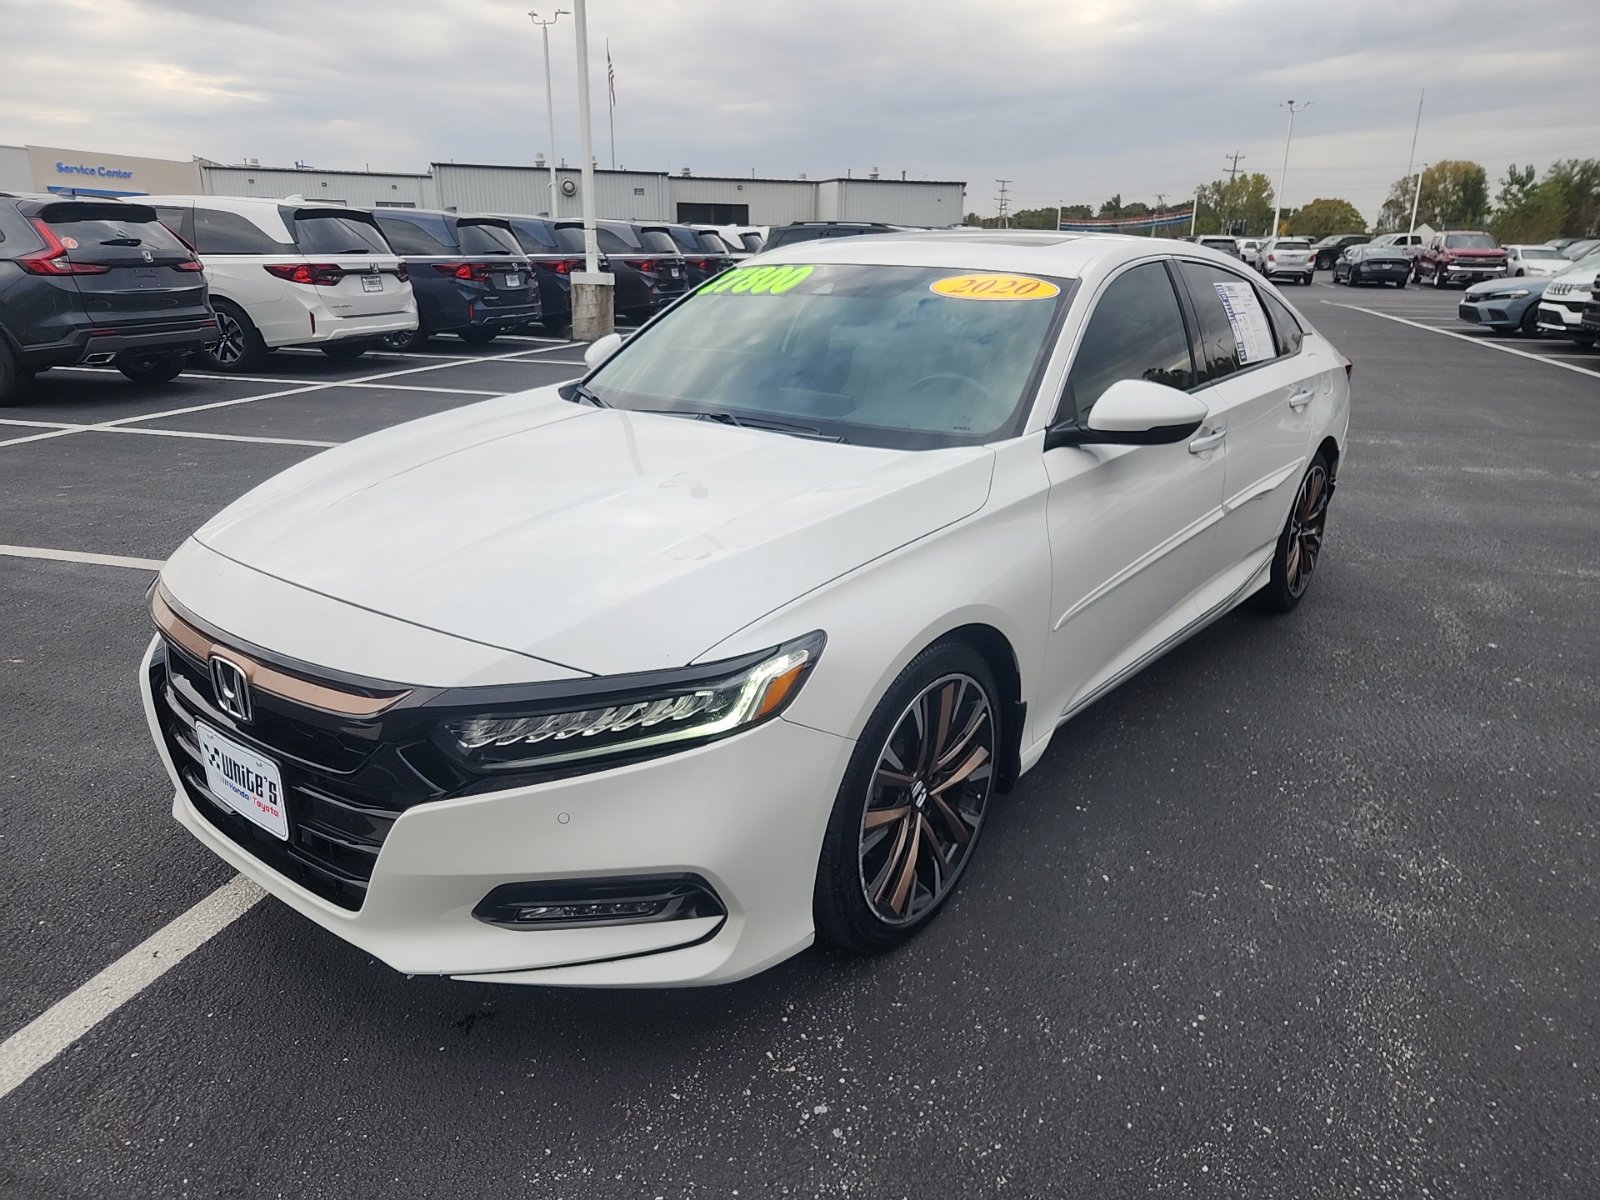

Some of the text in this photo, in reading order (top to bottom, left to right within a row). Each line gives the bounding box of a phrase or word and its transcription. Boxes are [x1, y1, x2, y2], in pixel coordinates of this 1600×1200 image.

[56, 162, 133, 179] Service Center
[949, 279, 1040, 295] 2020
[229, 783, 279, 817] Honda Toyota
